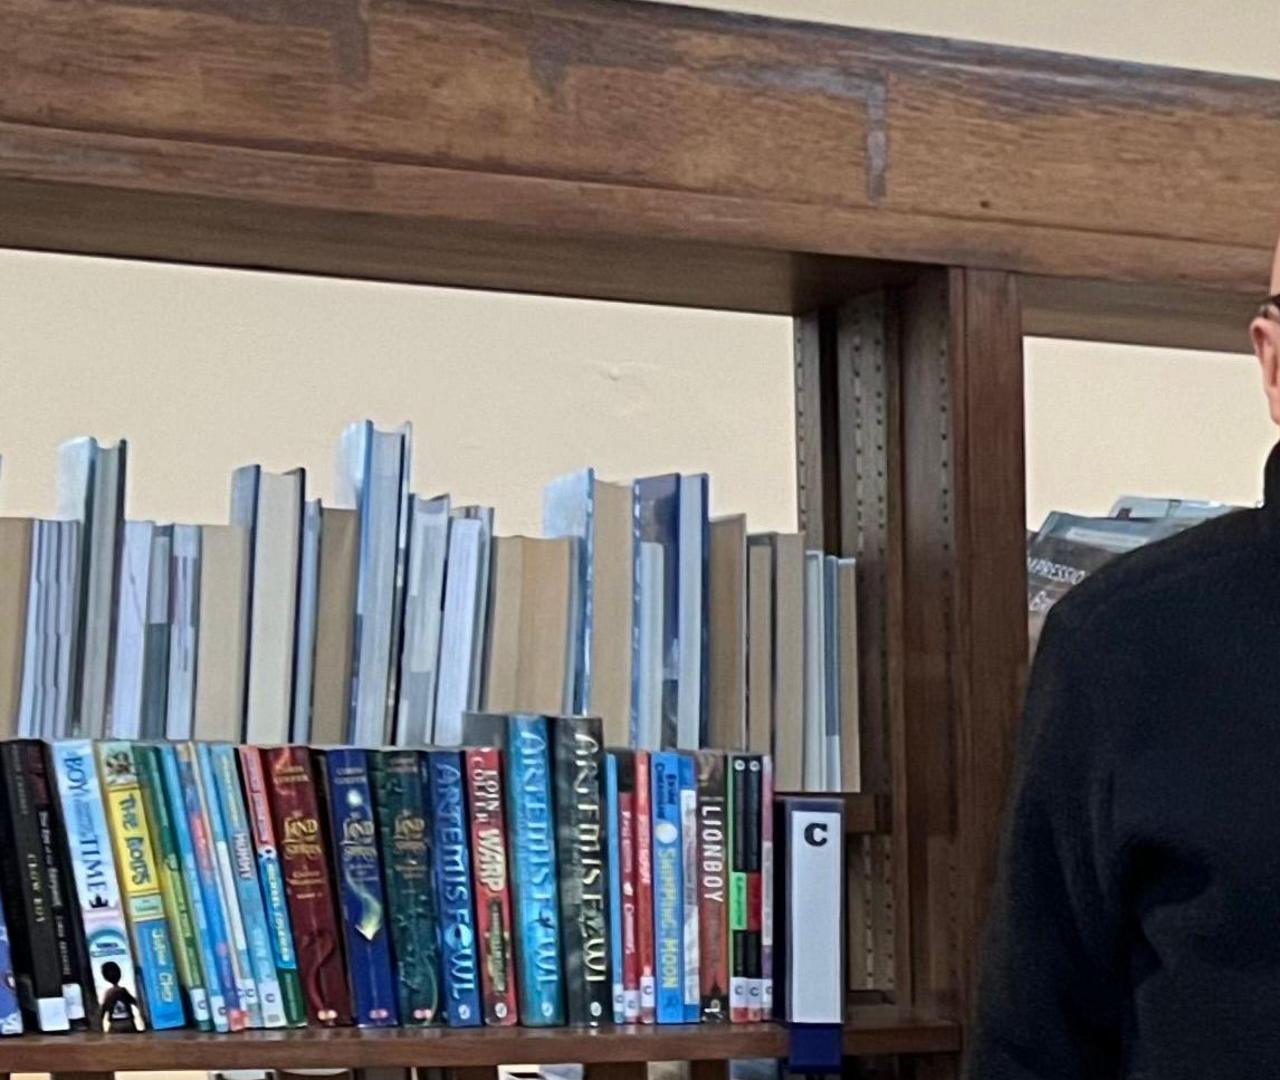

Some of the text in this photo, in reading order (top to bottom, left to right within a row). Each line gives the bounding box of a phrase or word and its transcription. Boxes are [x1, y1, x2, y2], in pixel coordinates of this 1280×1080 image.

[63, 756, 89, 795] BOY
[471, 756, 490, 823] COLFER
[482, 768, 501, 811] EOIN
[117, 793, 140, 831] THE
[571, 732, 604, 884] ARTEMIS
[804, 822, 829, 847] C
[76, 835, 109, 894] TIME
[430, 763, 476, 999] ARTEMIS FOWL
[476, 828, 506, 891] WARP
[518, 729, 558, 990] ARTEMIS FOWL
[701, 805, 722, 902] LIONBOY
